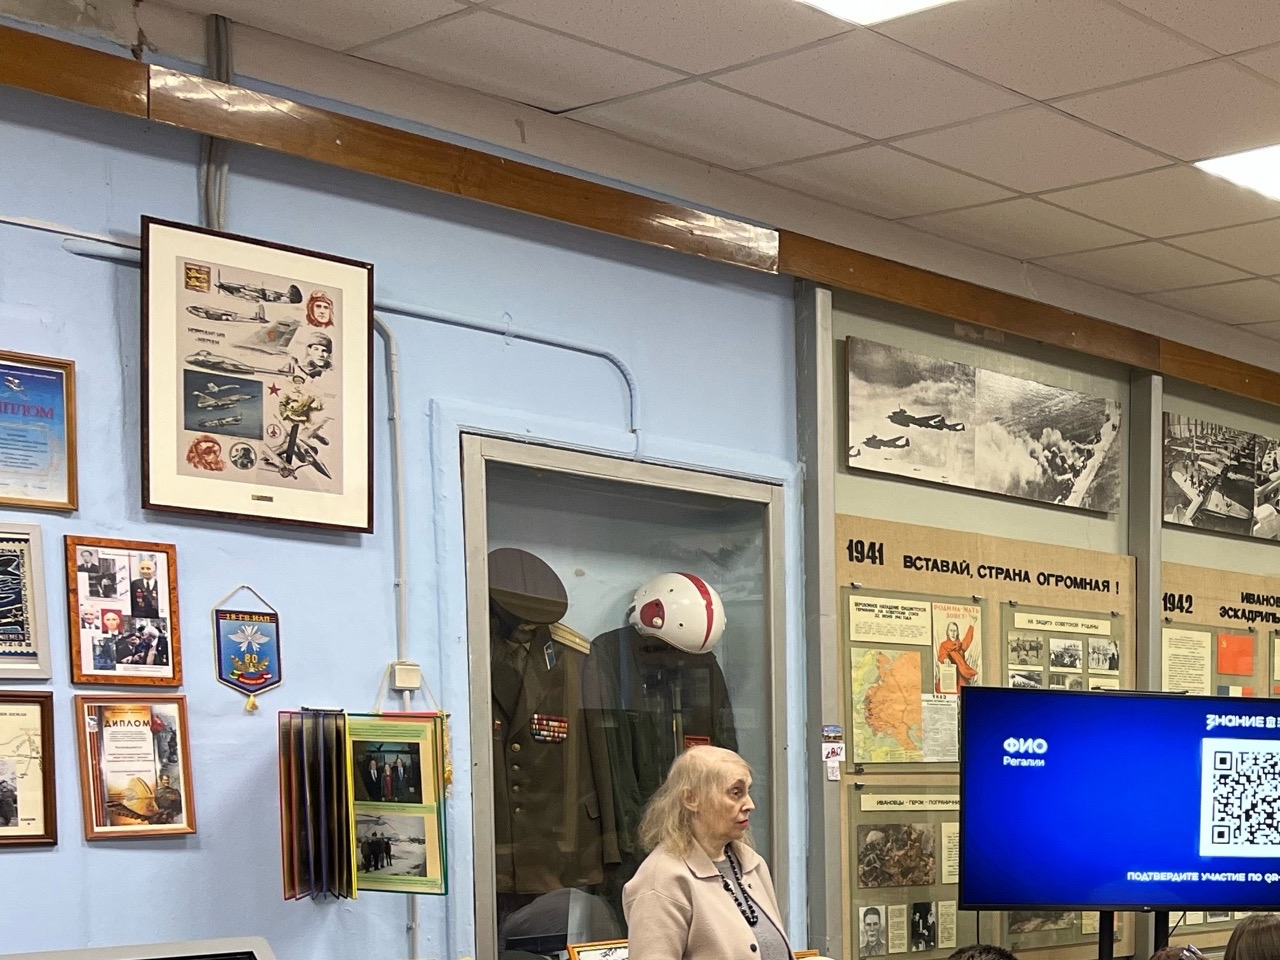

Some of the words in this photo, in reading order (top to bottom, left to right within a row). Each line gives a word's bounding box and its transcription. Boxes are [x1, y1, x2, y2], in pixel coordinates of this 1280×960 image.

[846, 538, 884, 566] 1941
[903, 554, 974, 580] ВСТАВАЙ,
[977, 564, 1031, 584] СТРАНА
[1036, 572, 1110, 593] ОГРОМНАЯ
[1162, 592, 1193, 614] 1942
[244, 653, 258, 663] 80
[104, 719, 151, 728] ДИПЛОМ
[1003, 737, 1048, 754] ФИО
[1003, 755, 1045, 767] Регалии
[1127, 871, 1199, 882] ПОДТВЕРДИТЕ
[1201, 872, 1246, 882] УЧАСТИЕ
[1248, 873, 1262, 882] ПО
